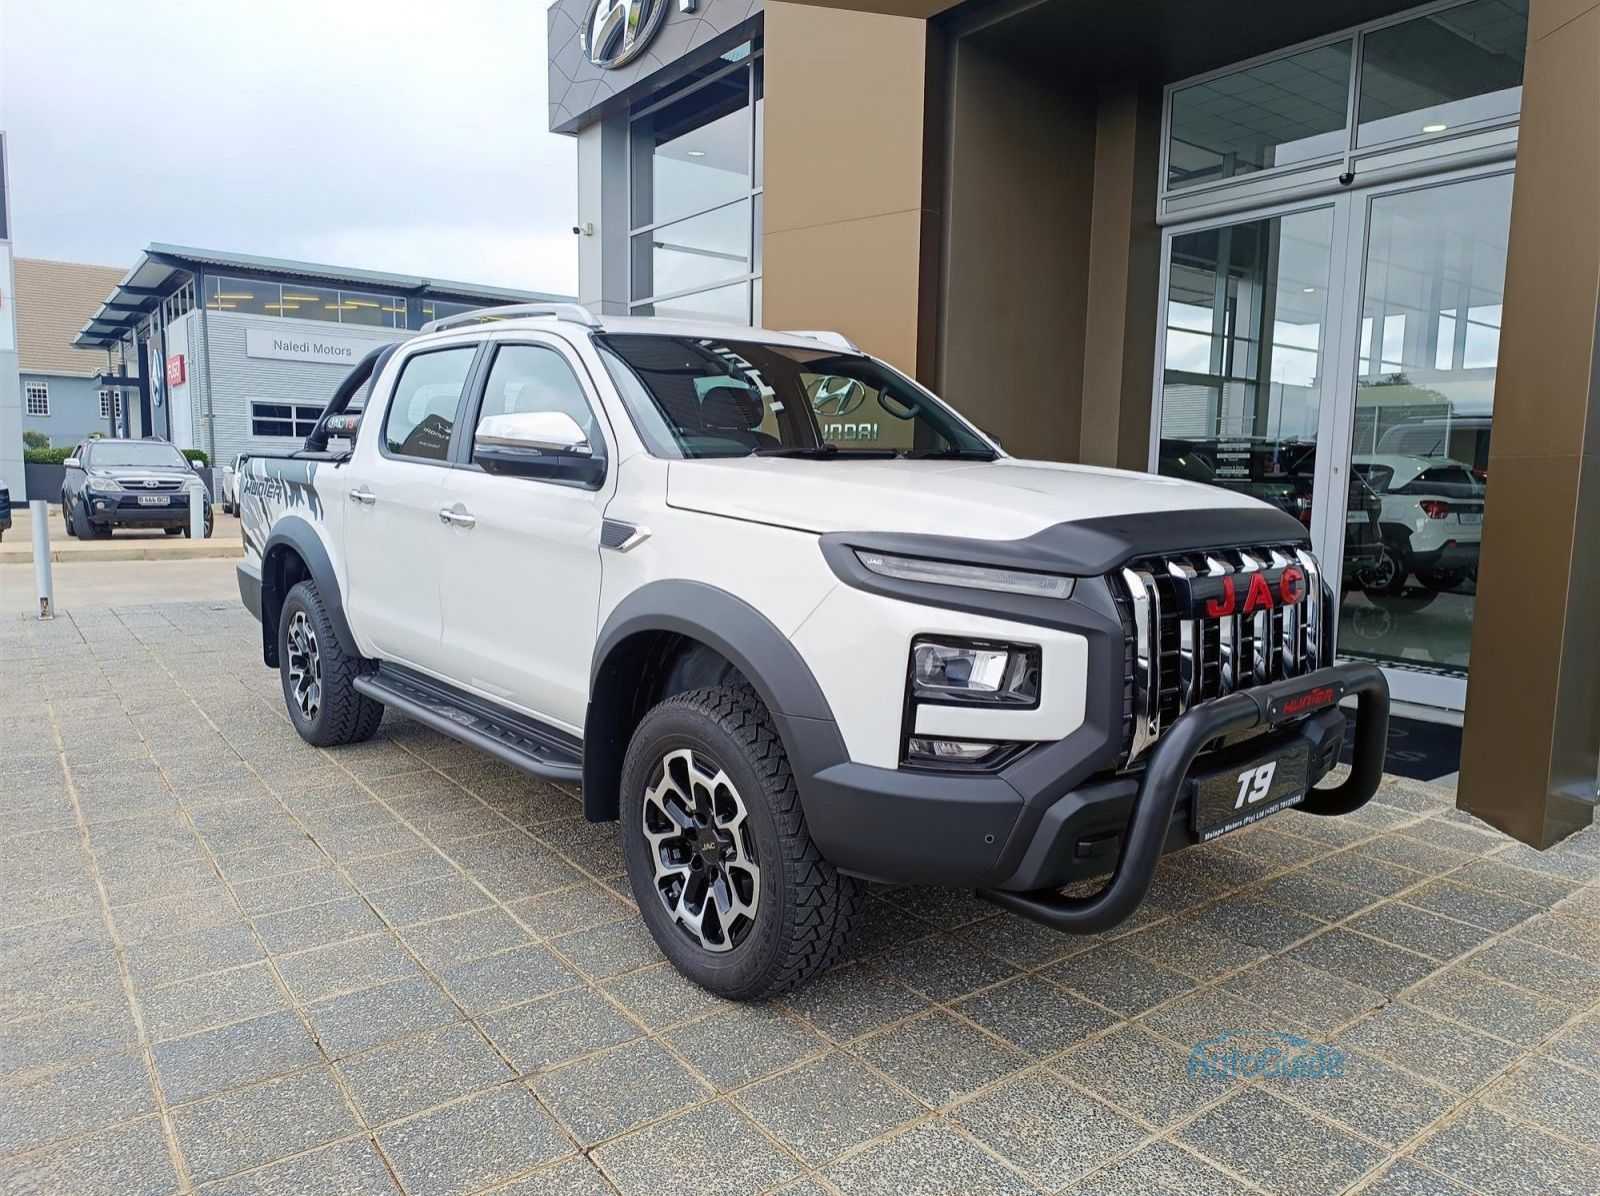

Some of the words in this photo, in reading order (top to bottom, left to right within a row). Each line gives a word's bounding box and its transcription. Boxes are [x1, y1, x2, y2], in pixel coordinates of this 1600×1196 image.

[273, 339, 310, 353] Naledi
[313, 342, 352, 356] Motors
[327, 417, 344, 429] JAC
[1206, 567, 1304, 618] JAC
[1283, 687, 1334, 716] HUNTER
[1234, 761, 1277, 810] T9
[1224, 820, 1242, 833] Motors
[701, 841, 716, 851] JAC
